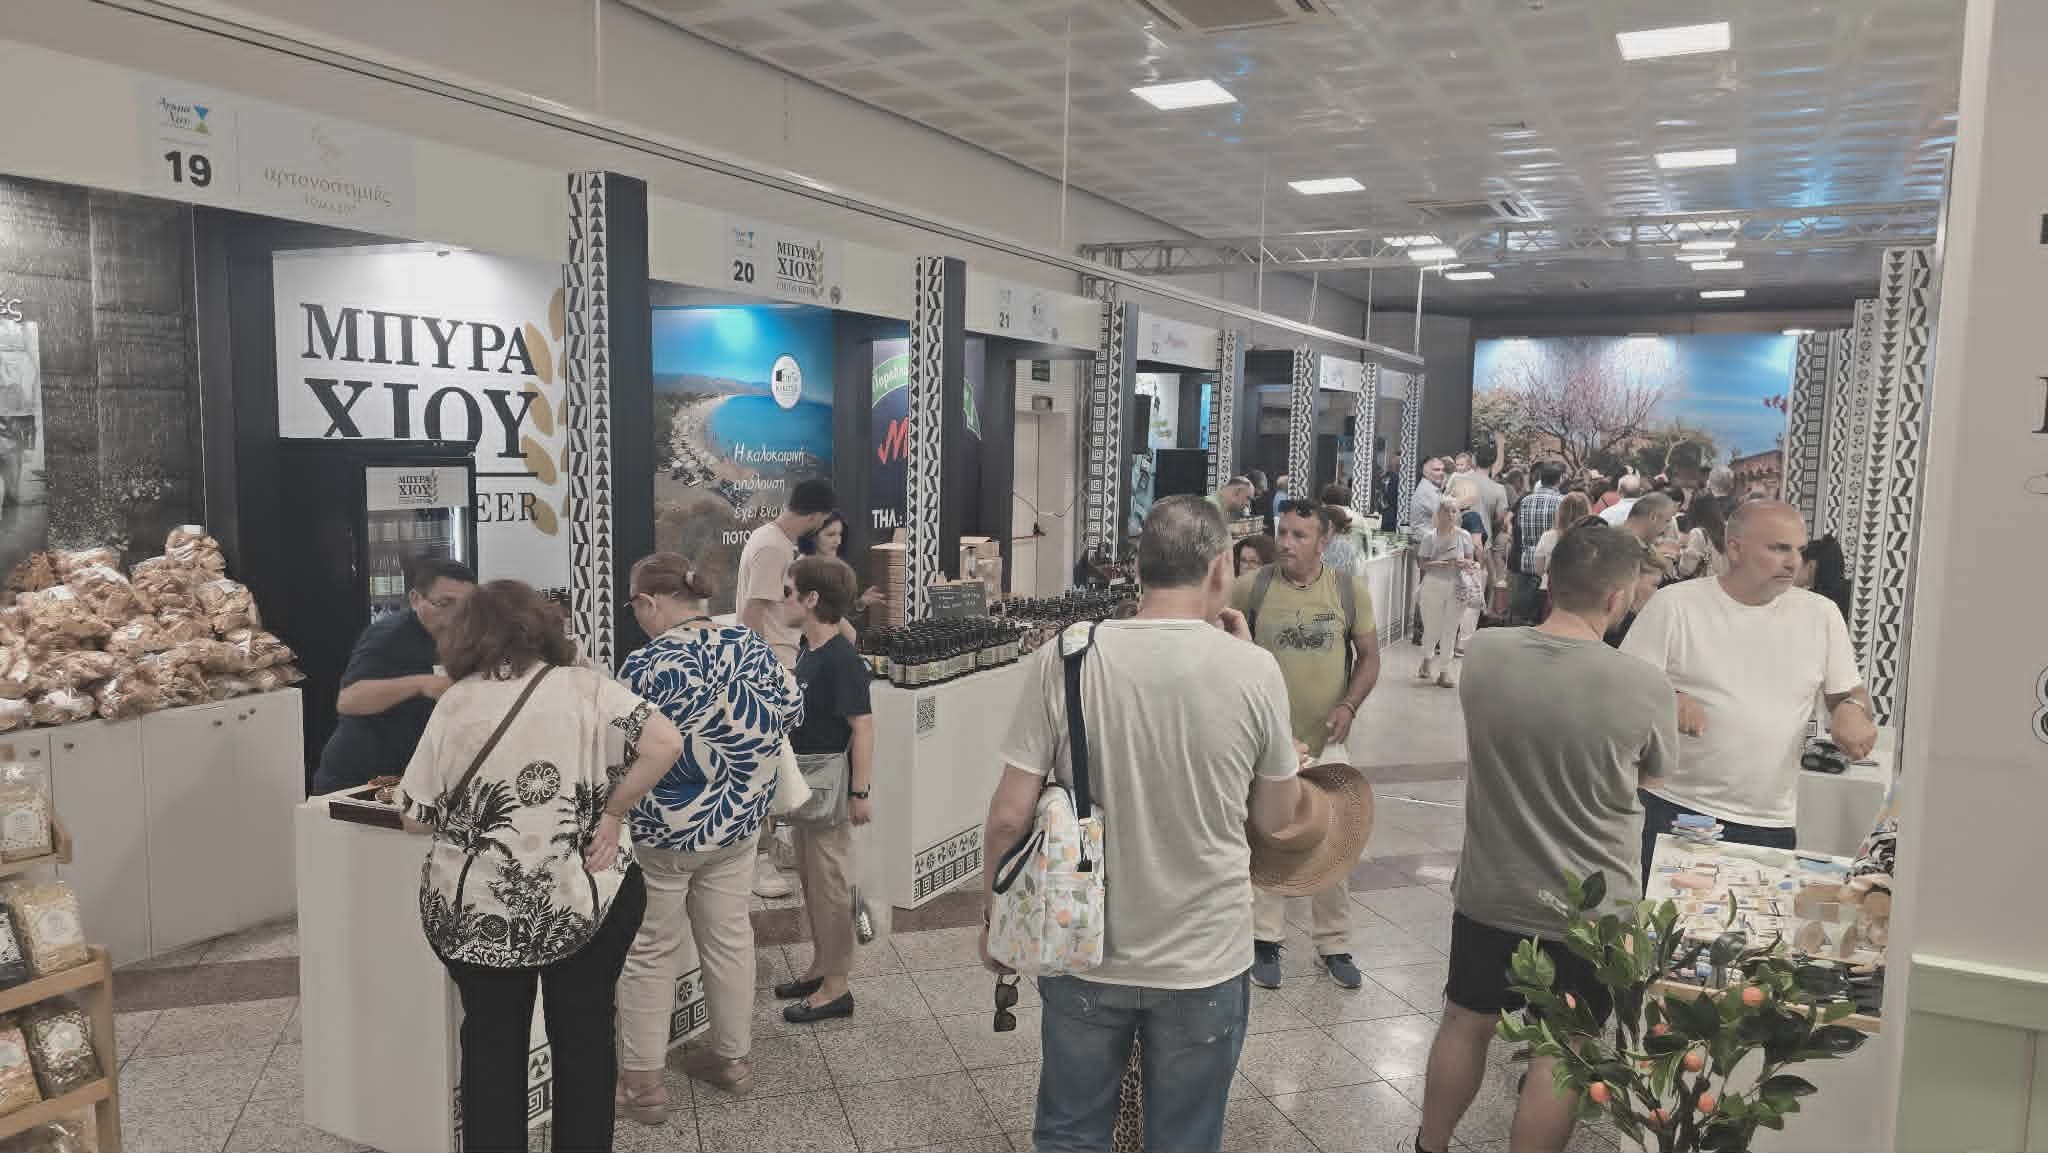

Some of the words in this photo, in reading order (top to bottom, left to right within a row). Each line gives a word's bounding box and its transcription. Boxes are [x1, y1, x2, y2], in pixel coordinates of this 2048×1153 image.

[164, 150, 212, 187] 19
[777, 241, 817, 261] ΜΠΥΡΑ
[733, 260, 755, 284] 20
[777, 257, 817, 281] ΧΙΟΥ
[300, 303, 539, 376] ΜΠΥΡΑ
[304, 377, 539, 458] ΧΙΟΥ
[734, 441, 745, 465] Η
[747, 442, 805, 465] καλοκαιρινή
